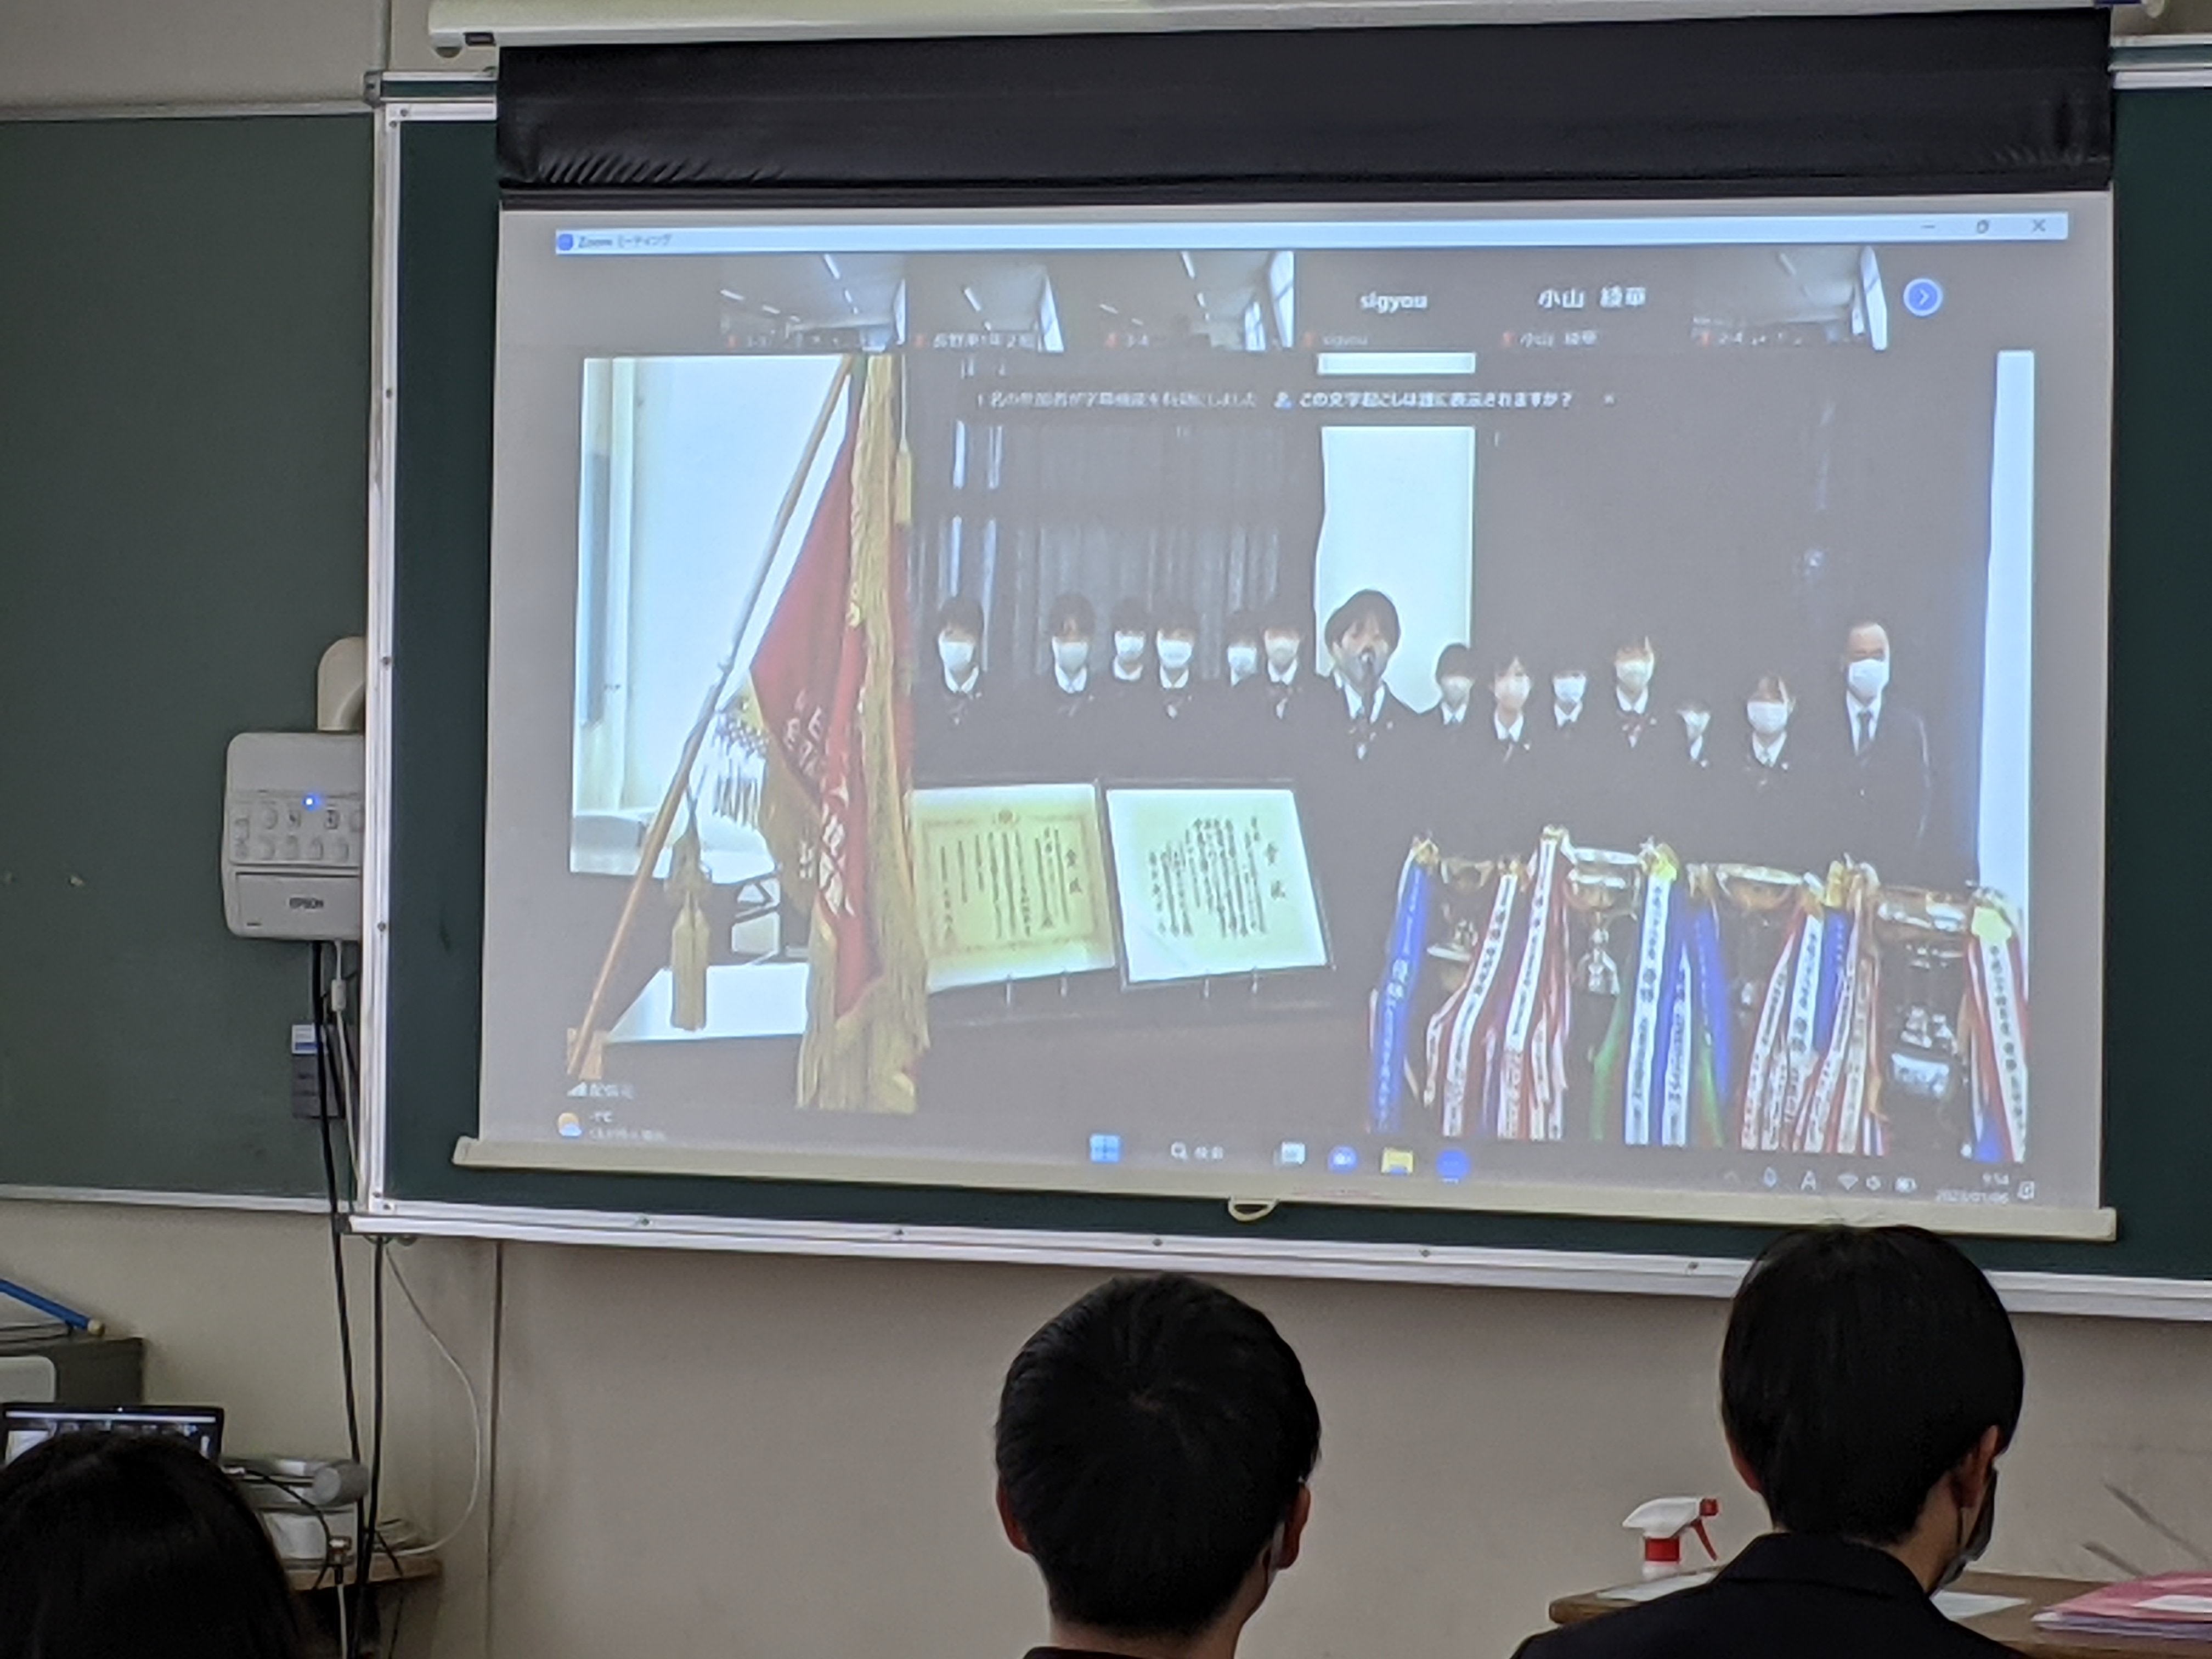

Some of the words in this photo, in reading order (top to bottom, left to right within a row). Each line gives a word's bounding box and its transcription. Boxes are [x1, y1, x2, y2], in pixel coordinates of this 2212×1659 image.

[1360, 291, 1427, 313] sigyou
[1538, 287, 1585, 308] 小山
[289, 897, 324, 910] EPSON
[1801, 1170, 1816, 1191] A
